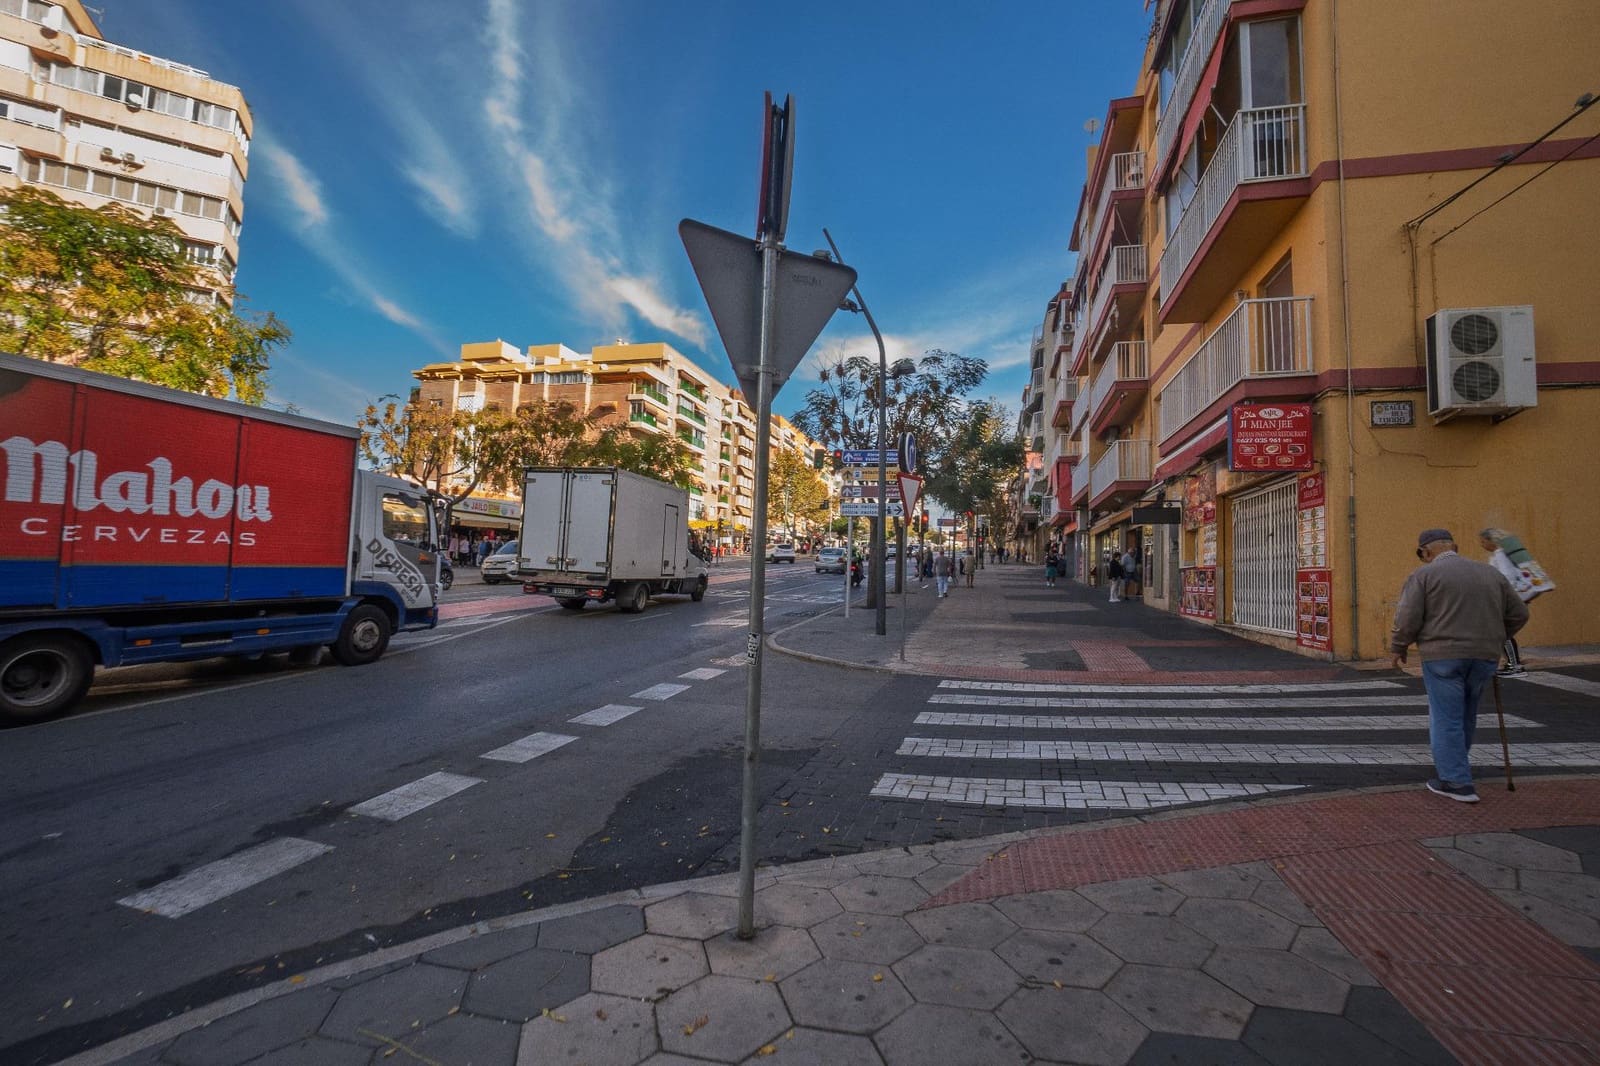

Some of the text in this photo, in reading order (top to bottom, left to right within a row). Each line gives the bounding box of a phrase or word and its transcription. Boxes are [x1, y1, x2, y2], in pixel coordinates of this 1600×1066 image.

[1250, 420, 1276, 429] MIAN
[1276, 420, 1294, 431] JEE
[0, 436, 273, 522] Mahou
[21, 518, 256, 546] CERVEZAS
[366, 538, 424, 598] DISBESA
